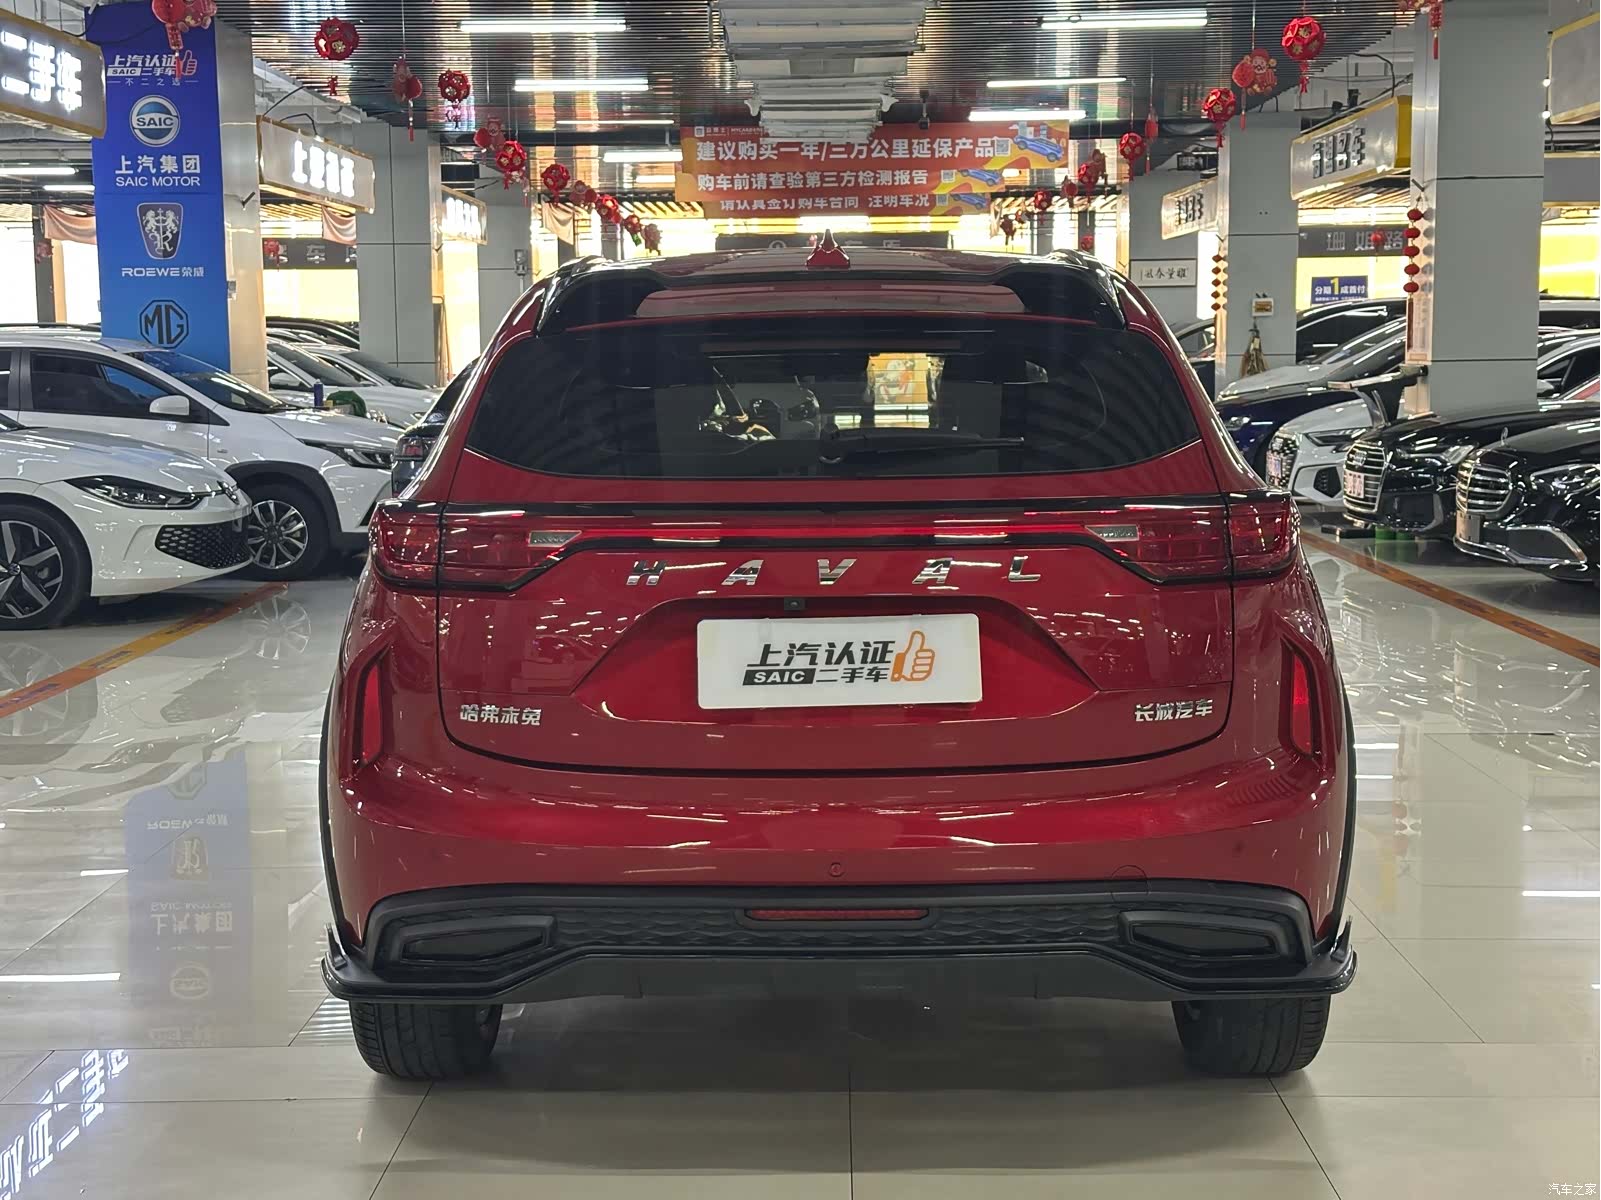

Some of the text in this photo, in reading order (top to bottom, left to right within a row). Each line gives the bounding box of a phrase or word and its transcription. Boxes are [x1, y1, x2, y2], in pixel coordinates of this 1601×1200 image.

[1, 31, 82, 112] 二手车
[109, 55, 177, 67] 上汽认证
[136, 117, 174, 127] SAIC
[697, 137, 994, 162] 建议购买一年/三万公里延保产品
[115, 155, 200, 174] 上汽集团
[116, 177, 200, 187] SAIC MOTOR
[697, 169, 928, 191] 购车前请查验第三方检测报告
[121, 267, 204, 277] ROEWE 荣威
[144, 304, 185, 345] MG
[626, 557, 1041, 586] HAVAL
[747, 641, 896, 667] 上汽认证
[753, 666, 890, 683] SAIC 二手车
[1135, 699, 1213, 722] 长城汽车
